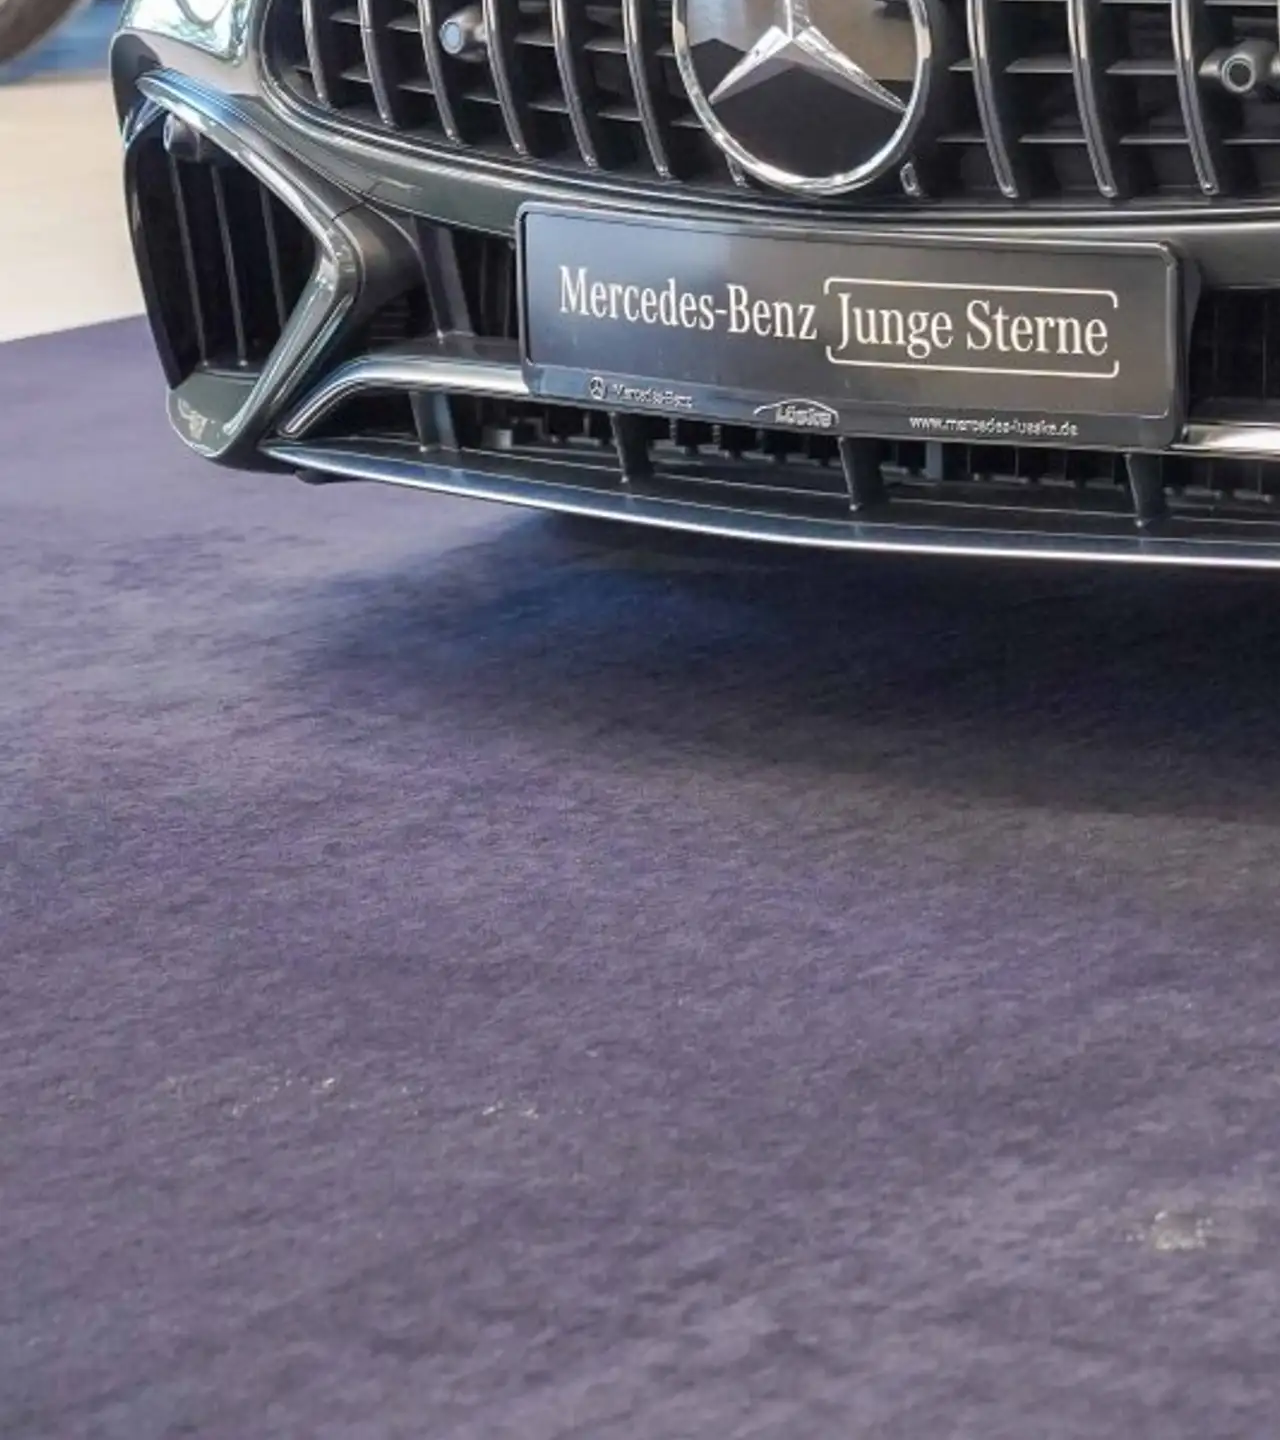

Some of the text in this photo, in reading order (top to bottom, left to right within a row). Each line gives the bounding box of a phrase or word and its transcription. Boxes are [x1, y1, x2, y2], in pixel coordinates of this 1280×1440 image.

[559, 265, 1109, 359] Mercedes-Benz Junge Sterne
